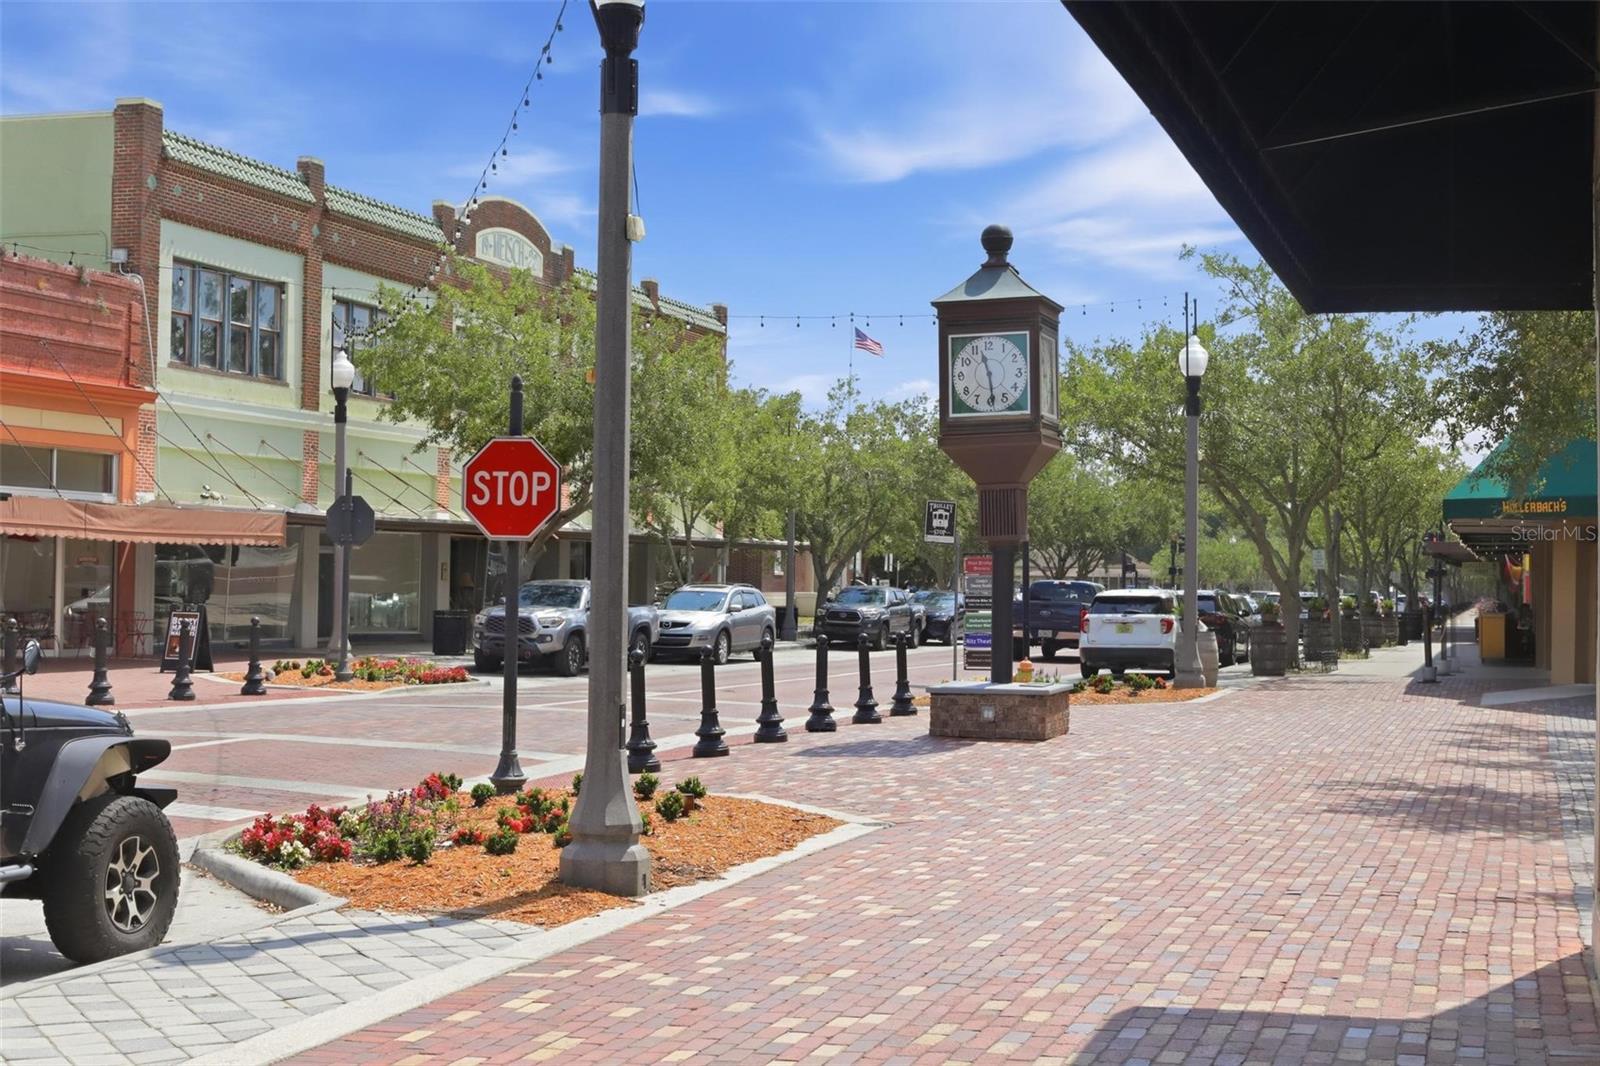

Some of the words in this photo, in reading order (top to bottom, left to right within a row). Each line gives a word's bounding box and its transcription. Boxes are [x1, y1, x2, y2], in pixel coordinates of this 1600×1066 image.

[971, 345, 979, 355] 11
[984, 341, 993, 351] 12
[961, 357, 971, 367] 10
[1011, 353, 1018, 363] 2
[957, 371, 965, 381] 9
[1015, 367, 1023, 378] 3
[963, 386, 970, 396] 8
[1011, 382, 1019, 392] 4
[974, 394, 980, 405] 7
[1001, 392, 1009, 403] 5
[472, 470, 551, 506] STOP
[929, 502, 953, 513] TROLLEY
